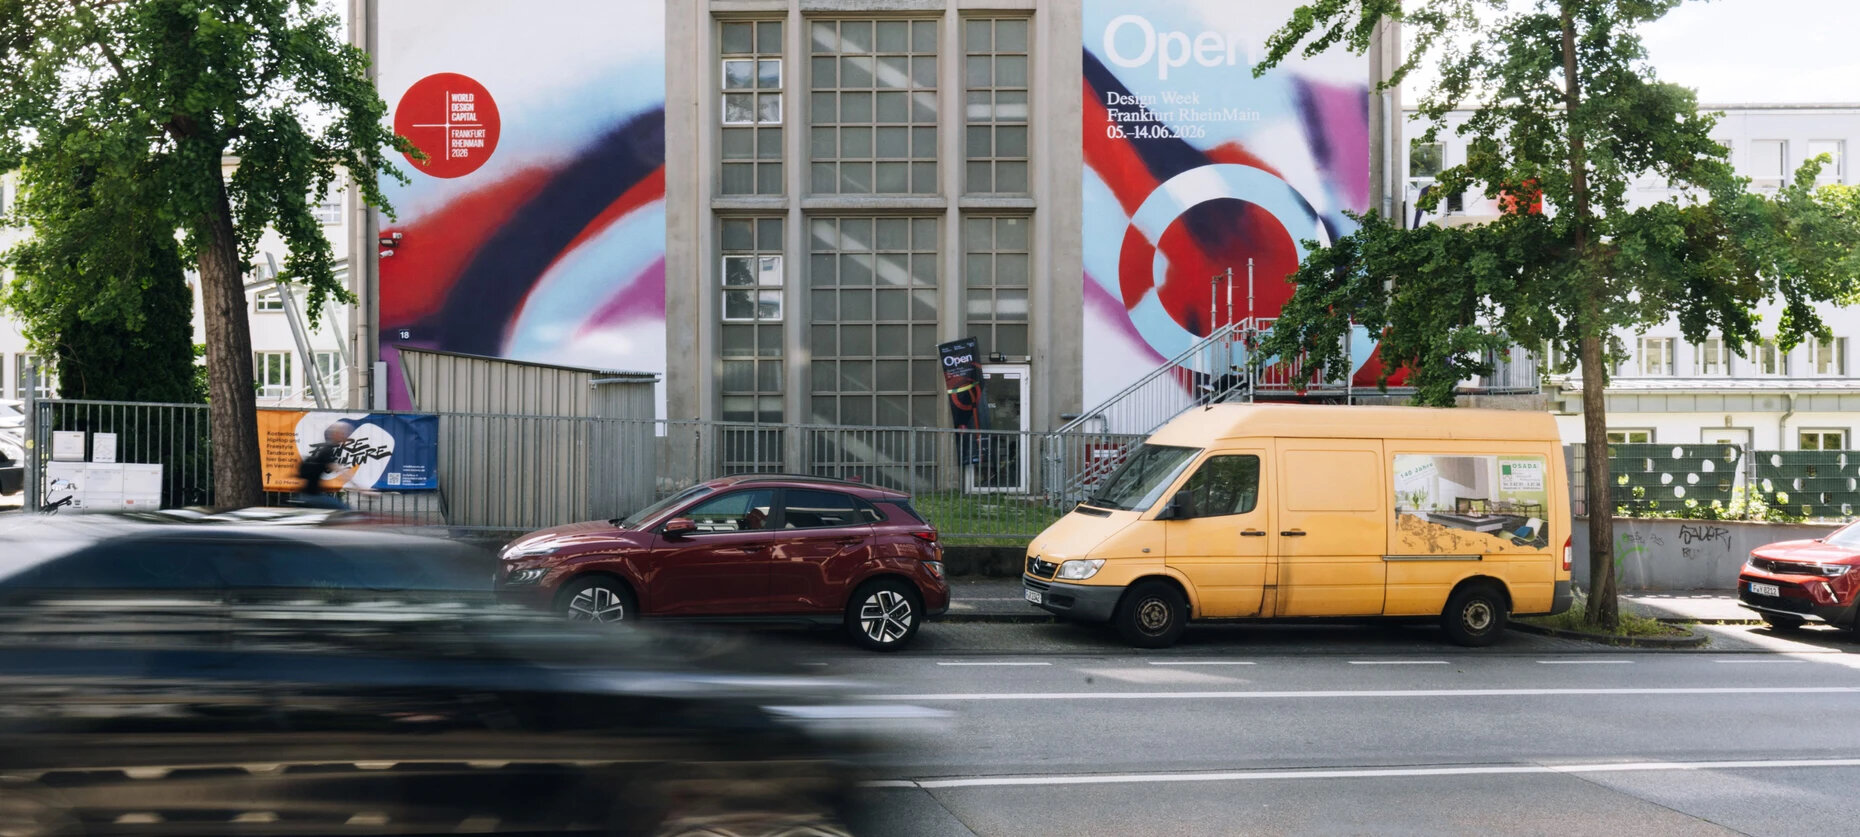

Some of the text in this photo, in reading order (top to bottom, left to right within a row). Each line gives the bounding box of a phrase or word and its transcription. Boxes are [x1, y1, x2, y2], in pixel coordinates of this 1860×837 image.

[1103, 14, 1256, 80] Open
[451, 93, 474, 102] WORLD
[1106, 91, 1200, 108] Design Week
[451, 103, 474, 111] DESIGN
[451, 113, 477, 121] CAPITAL
[1106, 108, 1260, 122] Frankfurt RheinMain
[451, 129, 486, 138] FRANKFURT
[451, 139, 484, 147] RHEINMAIN
[451, 149, 468, 158] 2026
[400, 331, 410, 339] 18
[944, 354, 972, 367] Open
